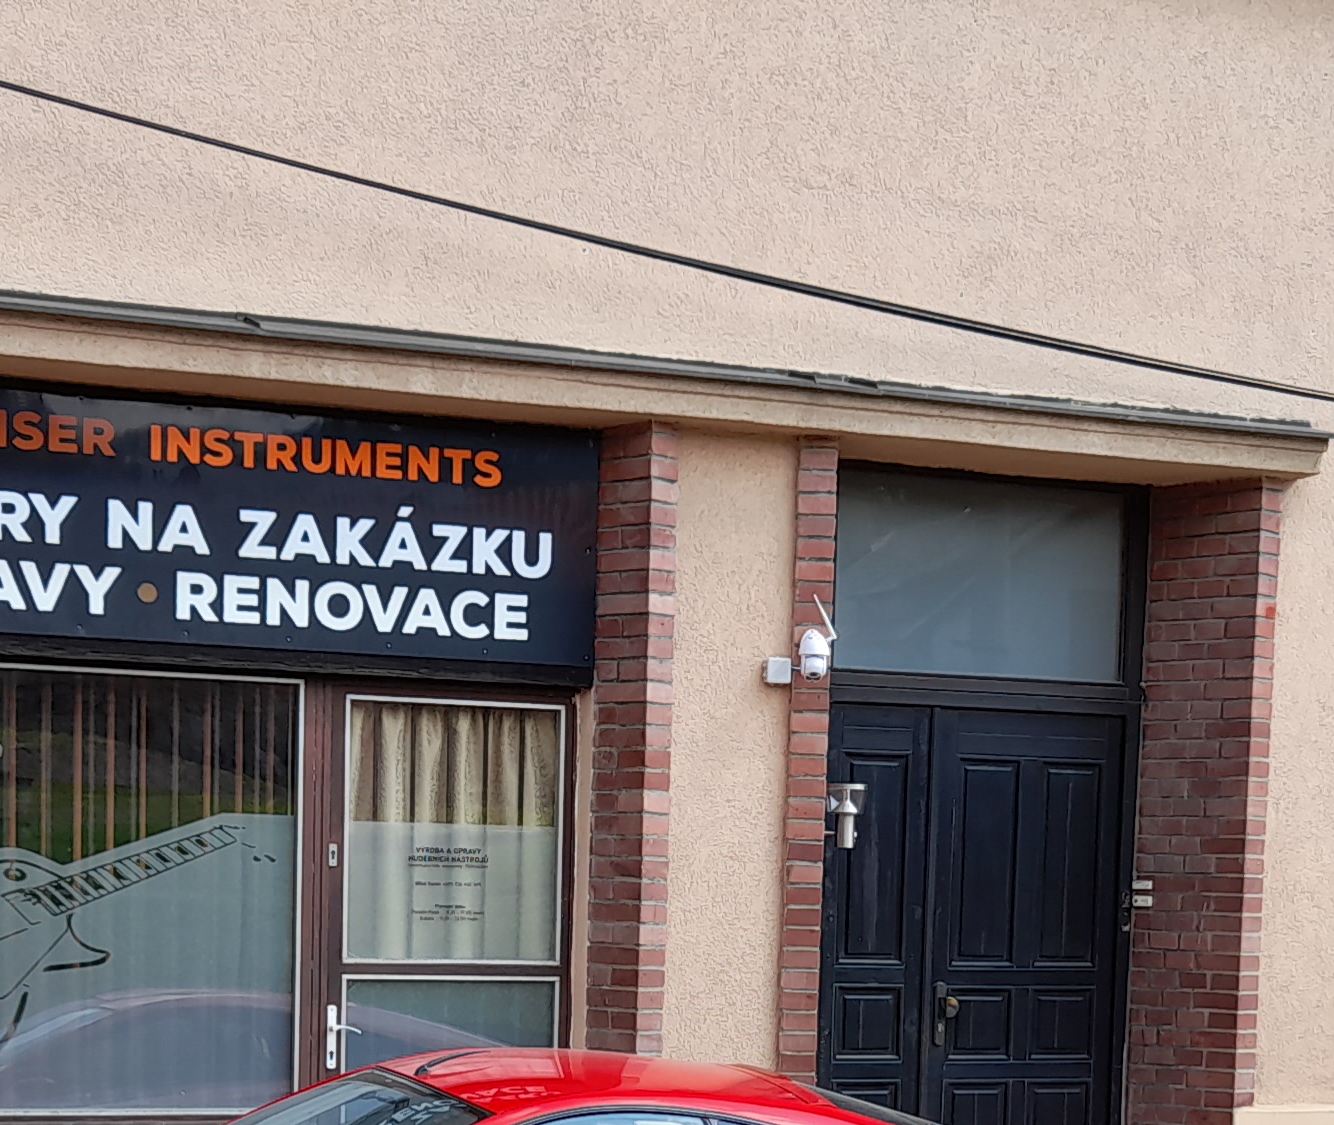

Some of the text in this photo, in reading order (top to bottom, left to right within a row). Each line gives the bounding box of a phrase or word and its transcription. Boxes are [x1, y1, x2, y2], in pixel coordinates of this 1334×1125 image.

[150, 424, 502, 488] INSTRUMENTS
[107, 498, 210, 556] NA
[238, 506, 553, 579] ZAKÁZKU
[175, 570, 529, 641] RENOVACE
